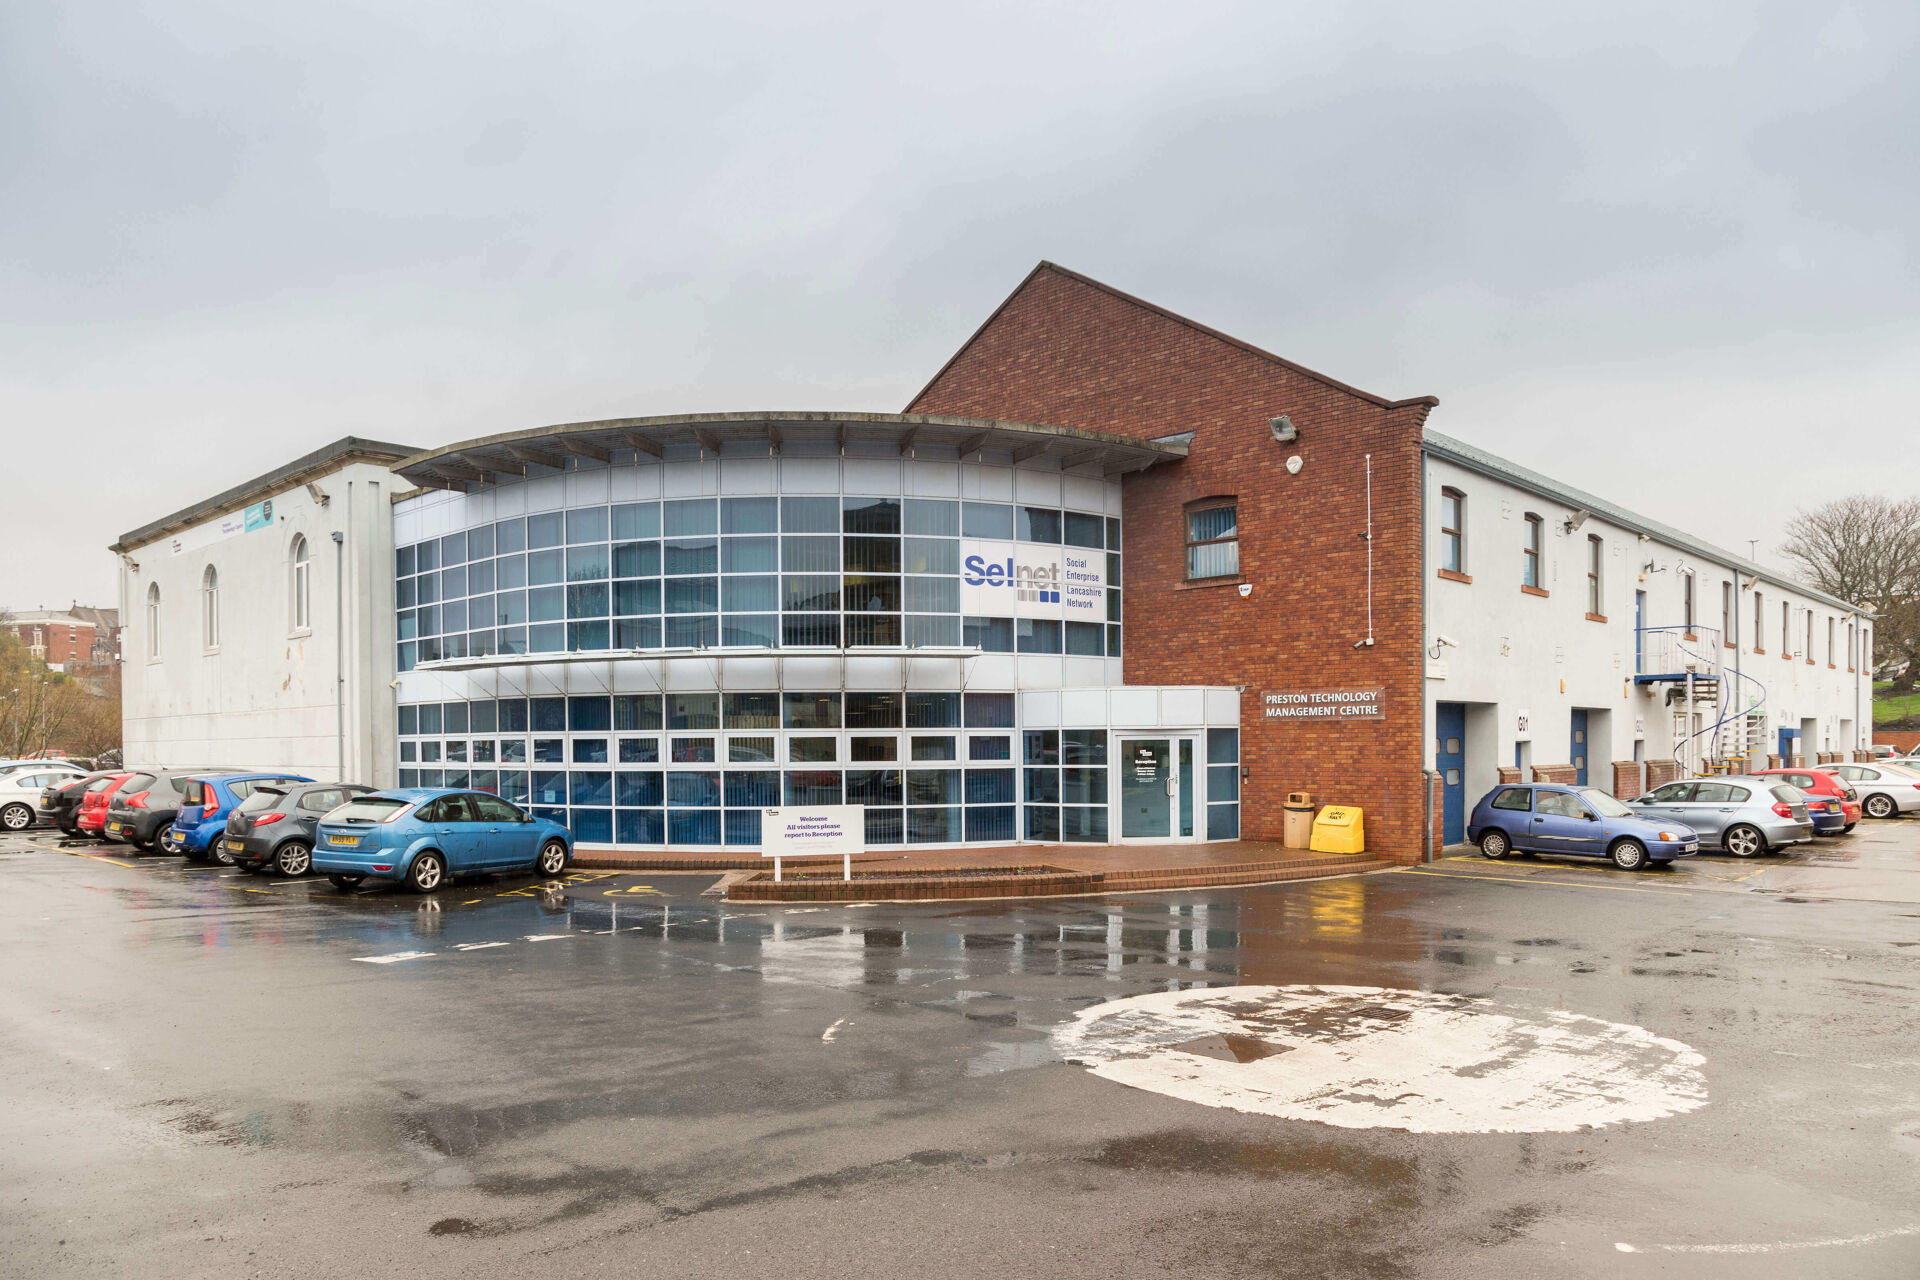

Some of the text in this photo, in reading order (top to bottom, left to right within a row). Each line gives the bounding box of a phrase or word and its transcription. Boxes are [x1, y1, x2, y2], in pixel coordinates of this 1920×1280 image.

[1066, 557, 1087, 568] Social
[964, 555, 1060, 590] Selnet
[1066, 570, 1100, 582] Enterprise
[1066, 586, 1102, 597] Lancashire
[1066, 598, 1094, 608] Network
[1266, 691, 1378, 704] PRESTON TECHNOLOGY
[1266, 705, 1378, 717] MANAGEMENT CENTRE
[812, 830, 843, 838] Reception
